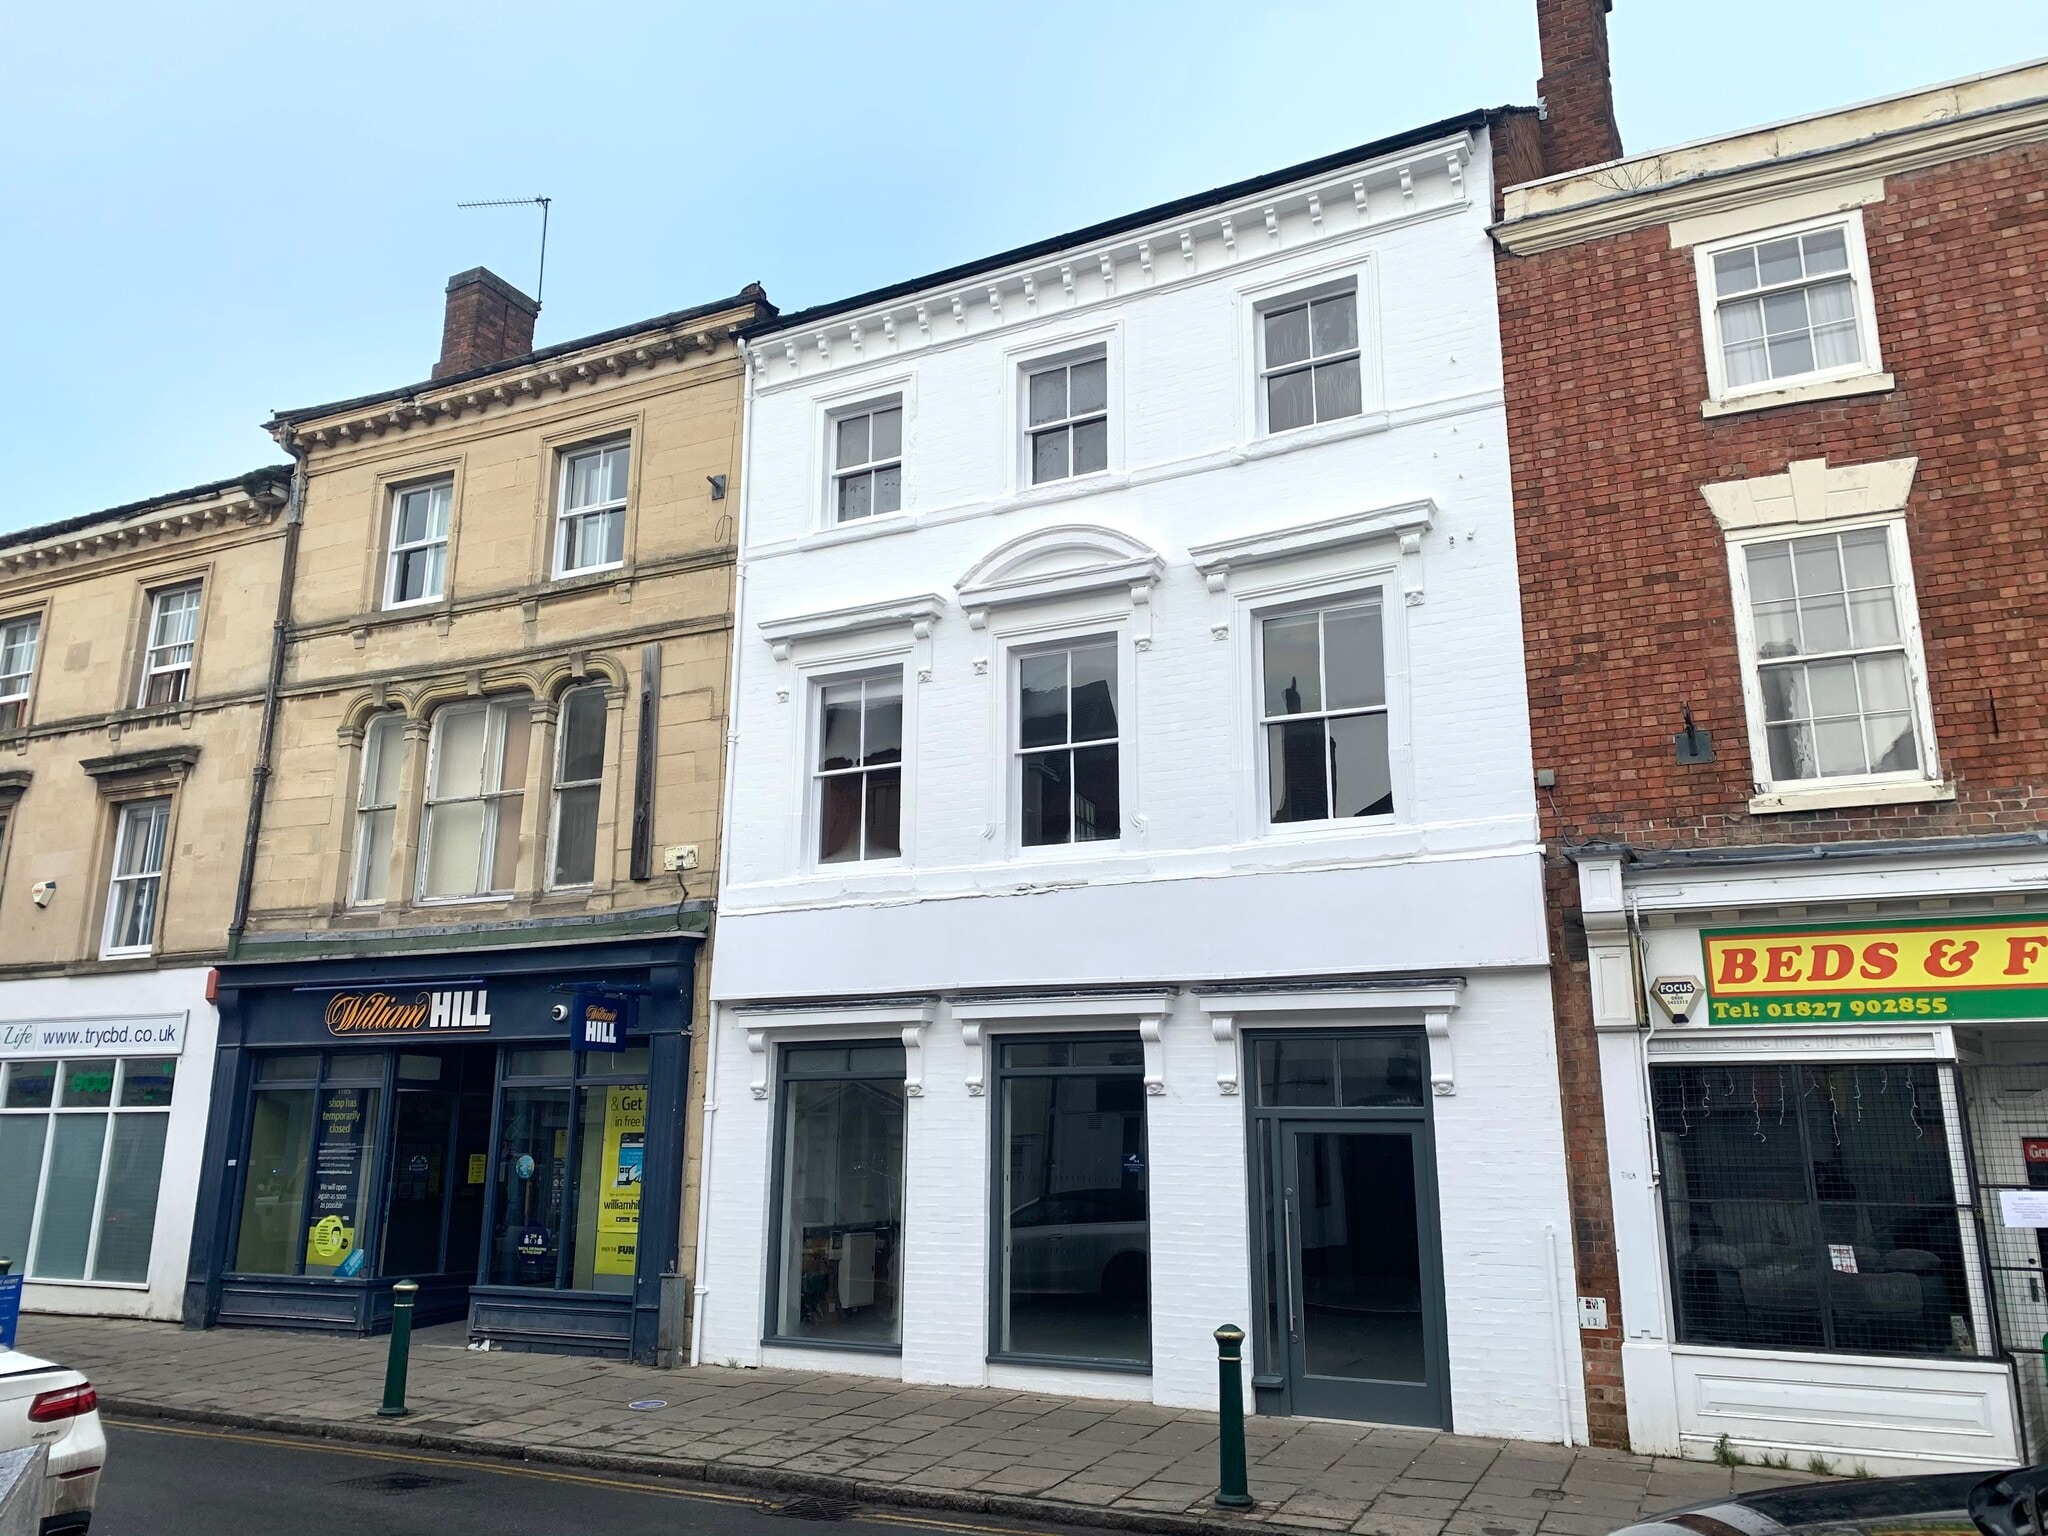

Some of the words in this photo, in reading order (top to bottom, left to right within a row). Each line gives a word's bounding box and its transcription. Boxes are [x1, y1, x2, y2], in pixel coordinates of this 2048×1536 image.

[1717, 942, 1899, 985] BEDS
[1923, 938, 1980, 978] &
[2002, 935, 2048, 976] F
[1660, 983, 1693, 993] FOCUS
[325, 992, 431, 1031] William
[429, 990, 491, 1028] HILL
[586, 1004, 618, 1022] William
[1712, 1002, 1760, 1018] Tel:
[1766, 1001, 1842, 1018] 01827
[1849, 997, 1948, 1017] 902855
[4, 1024, 32, 1050] Life
[43, 1024, 175, 1048] www.trycbd.co.uk
[585, 1020, 617, 1043] HILL
[328, 1098, 344, 1109] shop
[345, 1098, 357, 1108] has
[610, 1096, 618, 1111] &
[621, 1096, 643, 1111] Get
[322, 1110, 361, 1122] temporarily
[615, 1115, 622, 1127] in
[624, 1115, 640, 1127] free
[329, 1123, 351, 1133] closed
[617, 1245, 635, 1255] FUN
